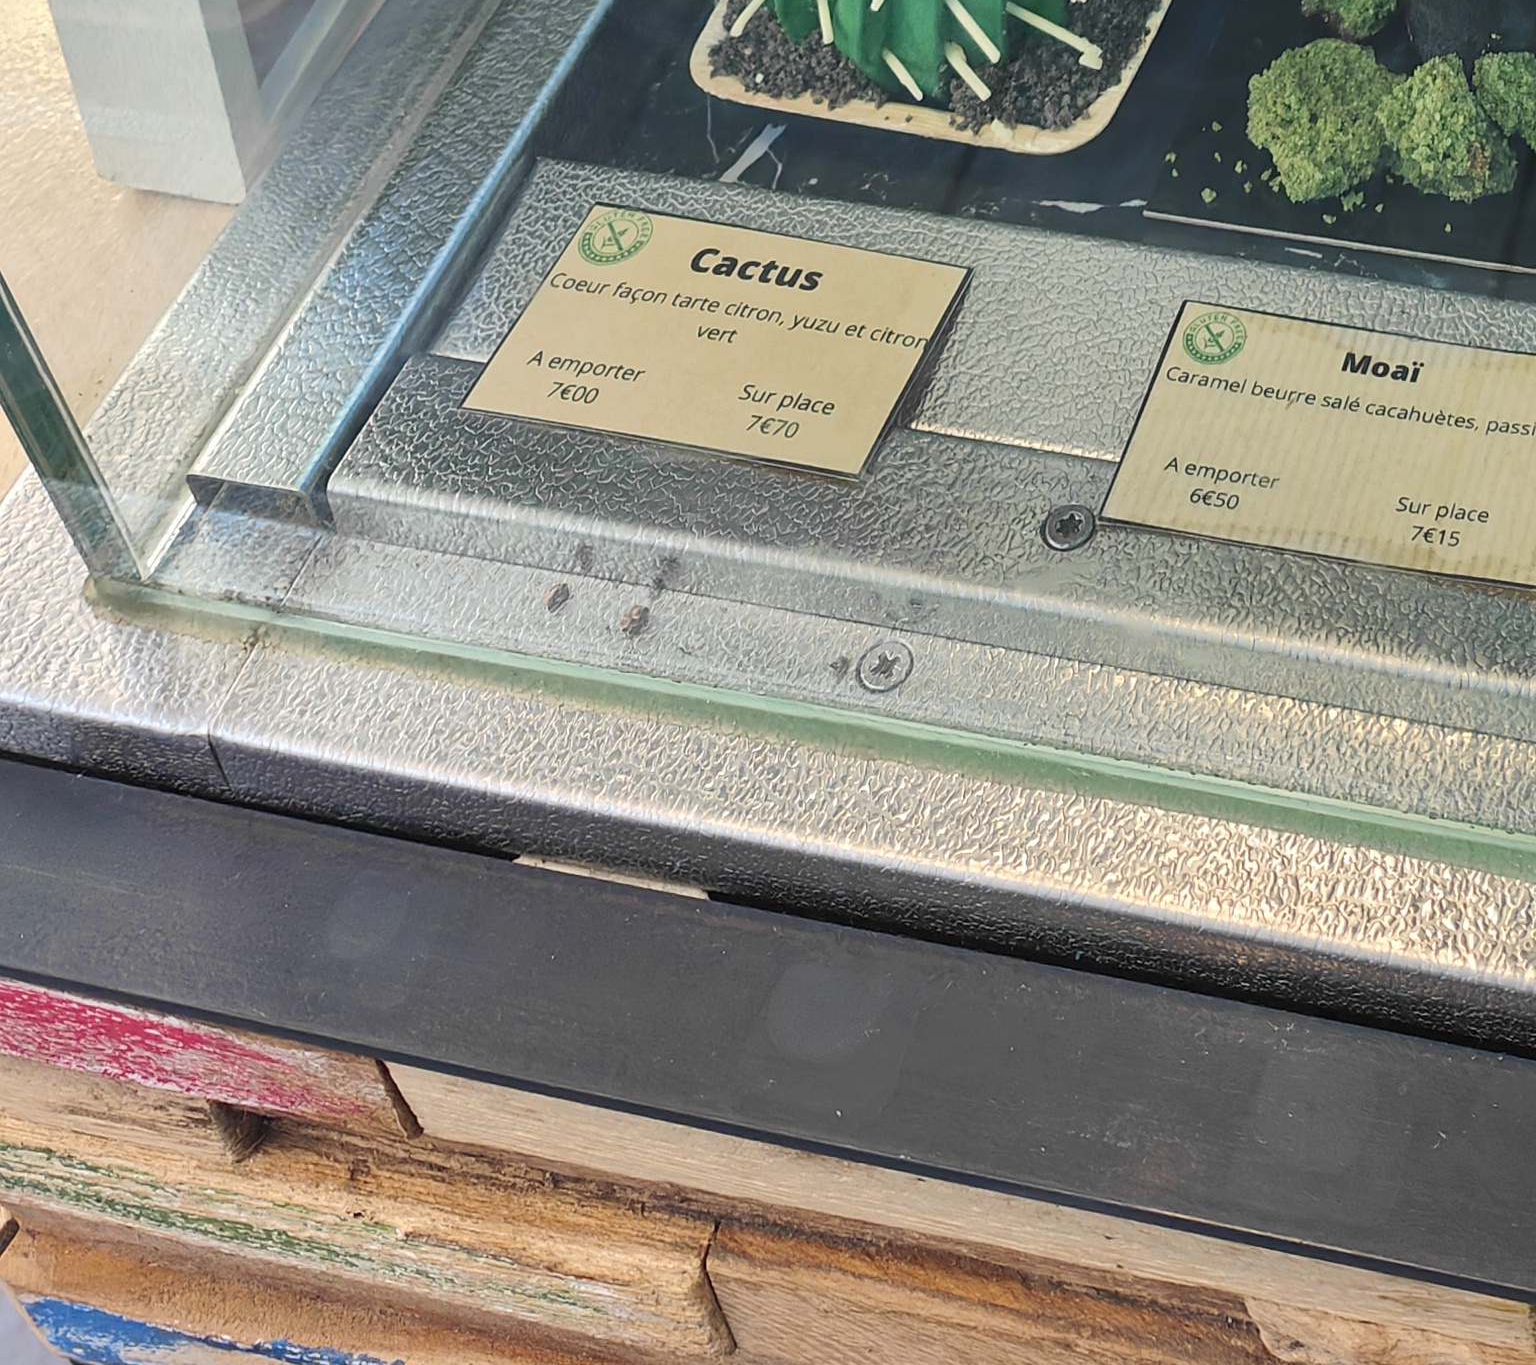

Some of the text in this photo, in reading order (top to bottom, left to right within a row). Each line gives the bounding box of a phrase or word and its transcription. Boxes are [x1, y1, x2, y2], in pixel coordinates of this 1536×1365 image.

[690, 247, 824, 292] Cactus
[549, 272, 929, 351] Coeur façon tarte citron, yuzu et citron
[697, 325, 739, 344] vert
[525, 350, 647, 383] A emporter
[1340, 349, 1425, 384] Moaï
[546, 381, 600, 405] 7€00
[737, 384, 836, 417] Sur place
[1166, 366, 1248, 394] Caramel
[1250, 380, 1317, 406] beurre
[1320, 394, 1361, 413] salé
[1364, 403, 1480, 432] cacahuètes,
[745, 414, 800, 439] 7€70
[1162, 456, 1281, 490] A emporter
[1189, 487, 1240, 510] 6€50
[1394, 496, 1490, 524] Sur place
[1411, 524, 1461, 548] 7€15
